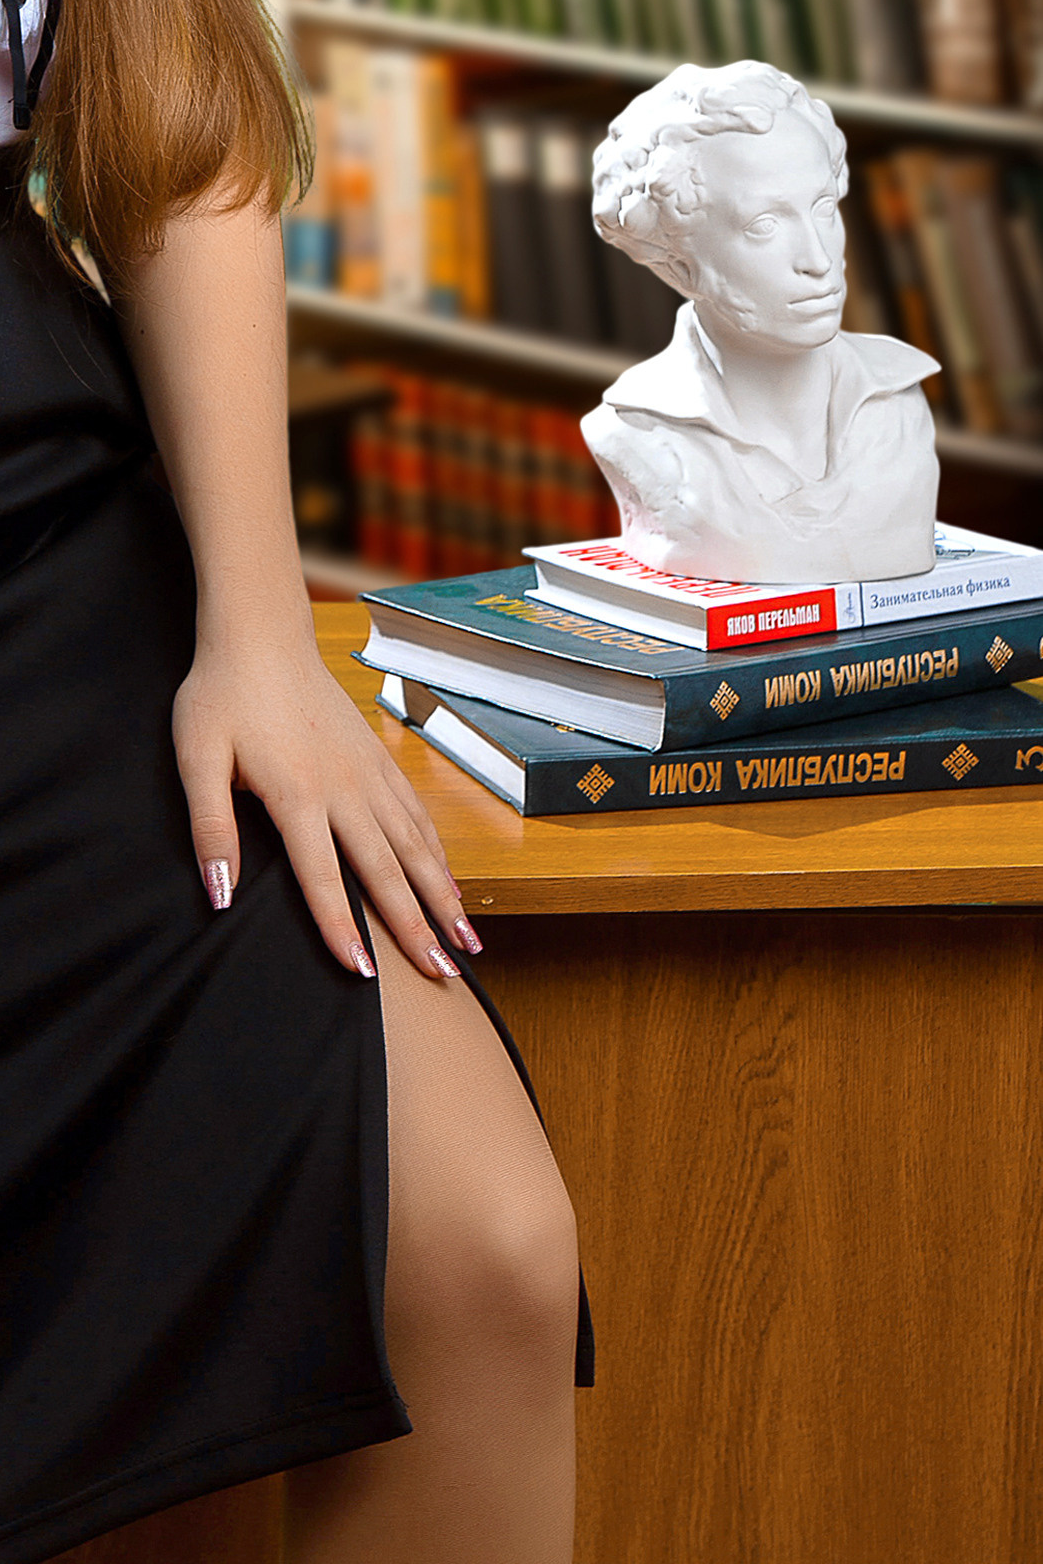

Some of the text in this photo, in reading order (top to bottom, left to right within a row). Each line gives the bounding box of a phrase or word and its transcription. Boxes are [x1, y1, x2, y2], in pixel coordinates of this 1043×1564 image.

[869, 583, 964, 610] Занимательная
[965, 575, 1011, 596] физика
[475, 594, 686, 655] РЕСПУБЛИКА
[726, 616, 756, 637] ЯКОВ
[757, 603, 821, 632] ПЕРЕЛЬМАН
[764, 647, 959, 708] РЕСПУБЛИКА КОМИ
[649, 750, 907, 795] РЕСПУБЛИКА КОМИ
